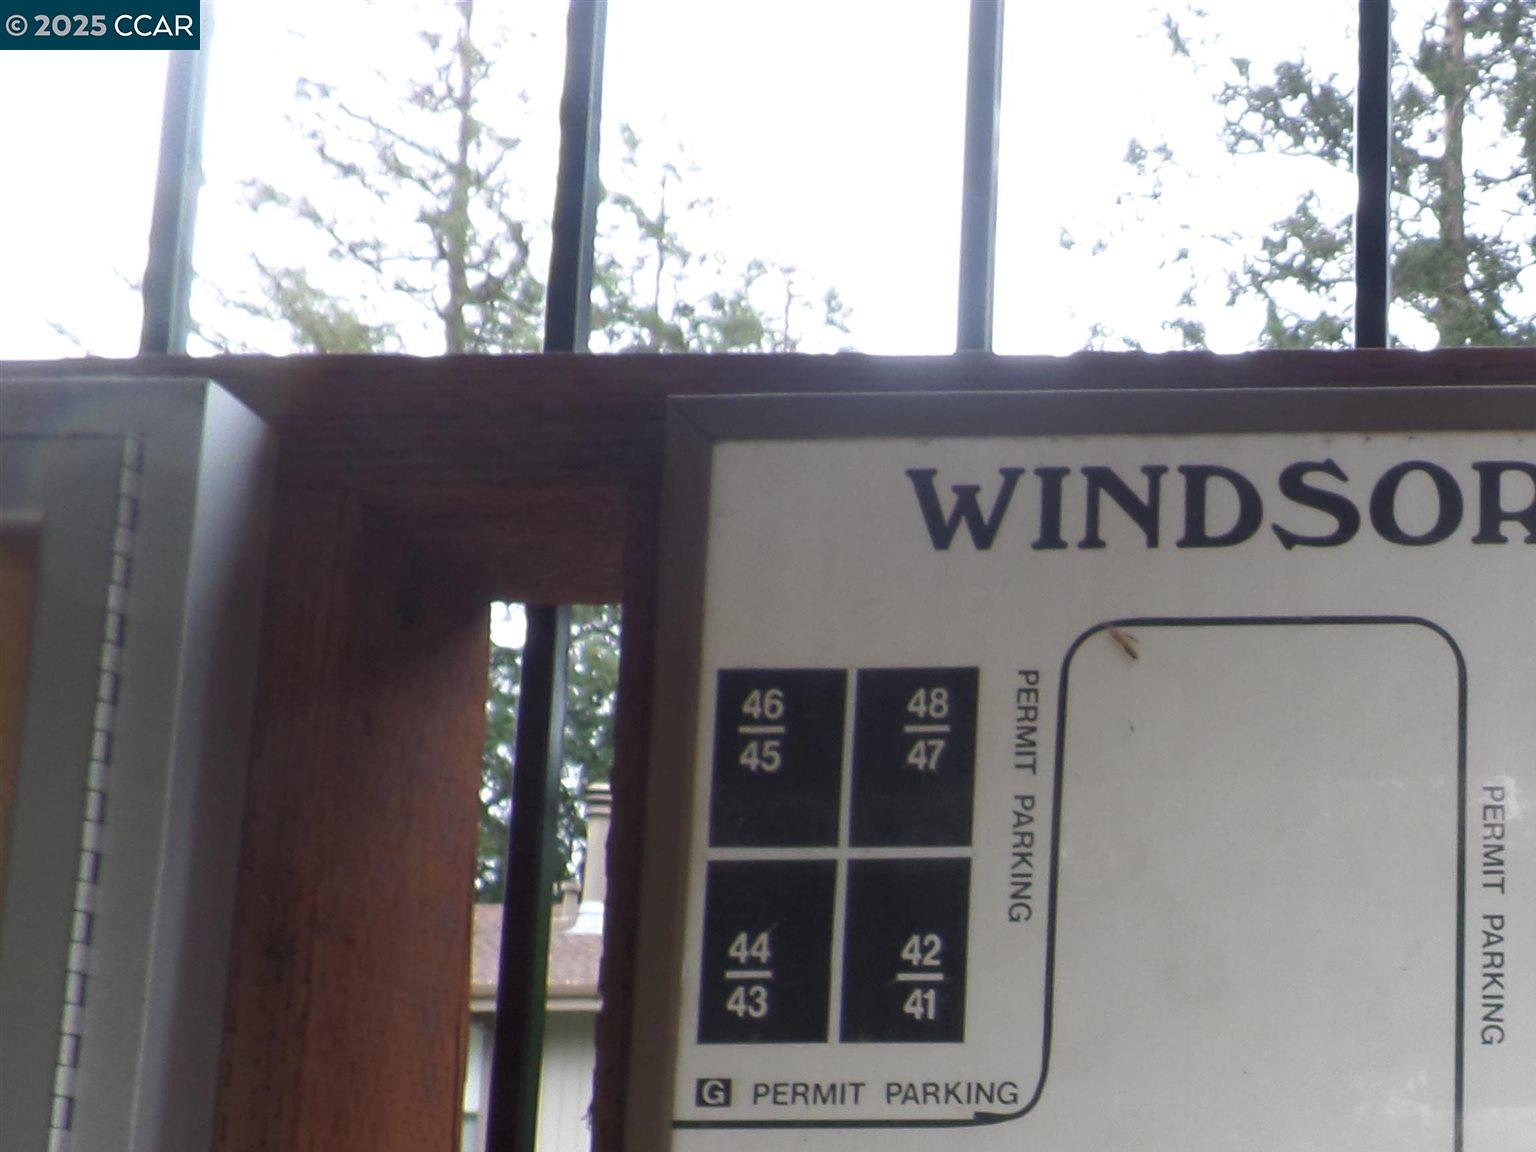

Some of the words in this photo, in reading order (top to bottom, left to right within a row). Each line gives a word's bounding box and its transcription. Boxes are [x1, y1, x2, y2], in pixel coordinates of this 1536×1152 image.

[741, 689, 785, 719] 46
[907, 688, 949, 719] 48
[1014, 669, 1040, 773] PERMIT
[738, 741, 782, 772] 45
[907, 740, 945, 771] 47
[1480, 785, 1505, 893] PERMIT
[1007, 794, 1036, 924] PARKING
[728, 934, 772, 964] 44
[902, 935, 943, 965] 42
[1480, 913, 1506, 1046] PARKING
[726, 987, 769, 1017] 43
[903, 988, 938, 1019] 41
[700, 1080, 727, 1106] G
[752, 1081, 864, 1106] PERMIT
[885, 1081, 1019, 1106] PARKING
